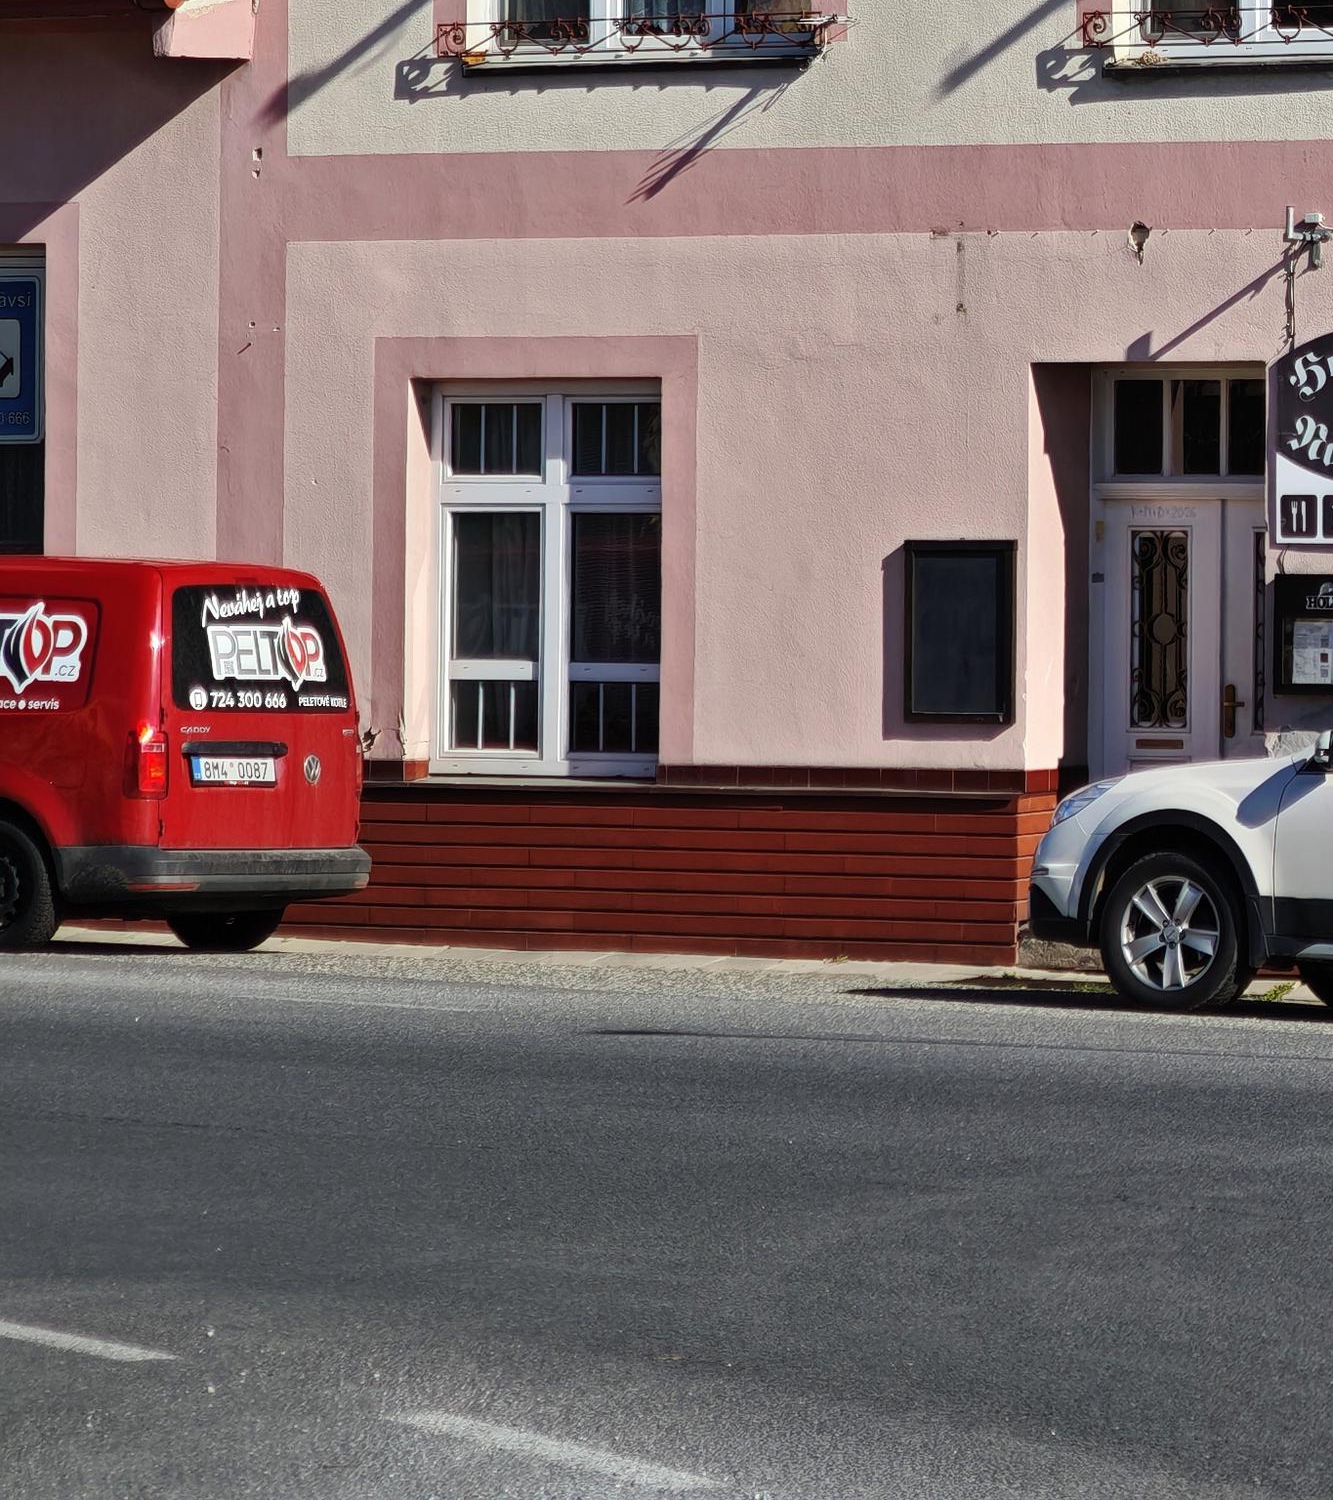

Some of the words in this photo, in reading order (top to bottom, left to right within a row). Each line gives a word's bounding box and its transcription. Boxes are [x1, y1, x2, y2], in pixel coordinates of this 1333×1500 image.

[201, 589, 264, 628] Neváhej
[266, 594, 275, 609] a
[277, 588, 300, 614] top
[210, 620, 321, 684] PELTOP
[28, 697, 60, 710] servis
[209, 691, 235, 708] 724
[237, 691, 263, 708] 300
[265, 692, 287, 708] 666
[203, 760, 229, 779] 8M4
[237, 761, 268, 780] 0087
